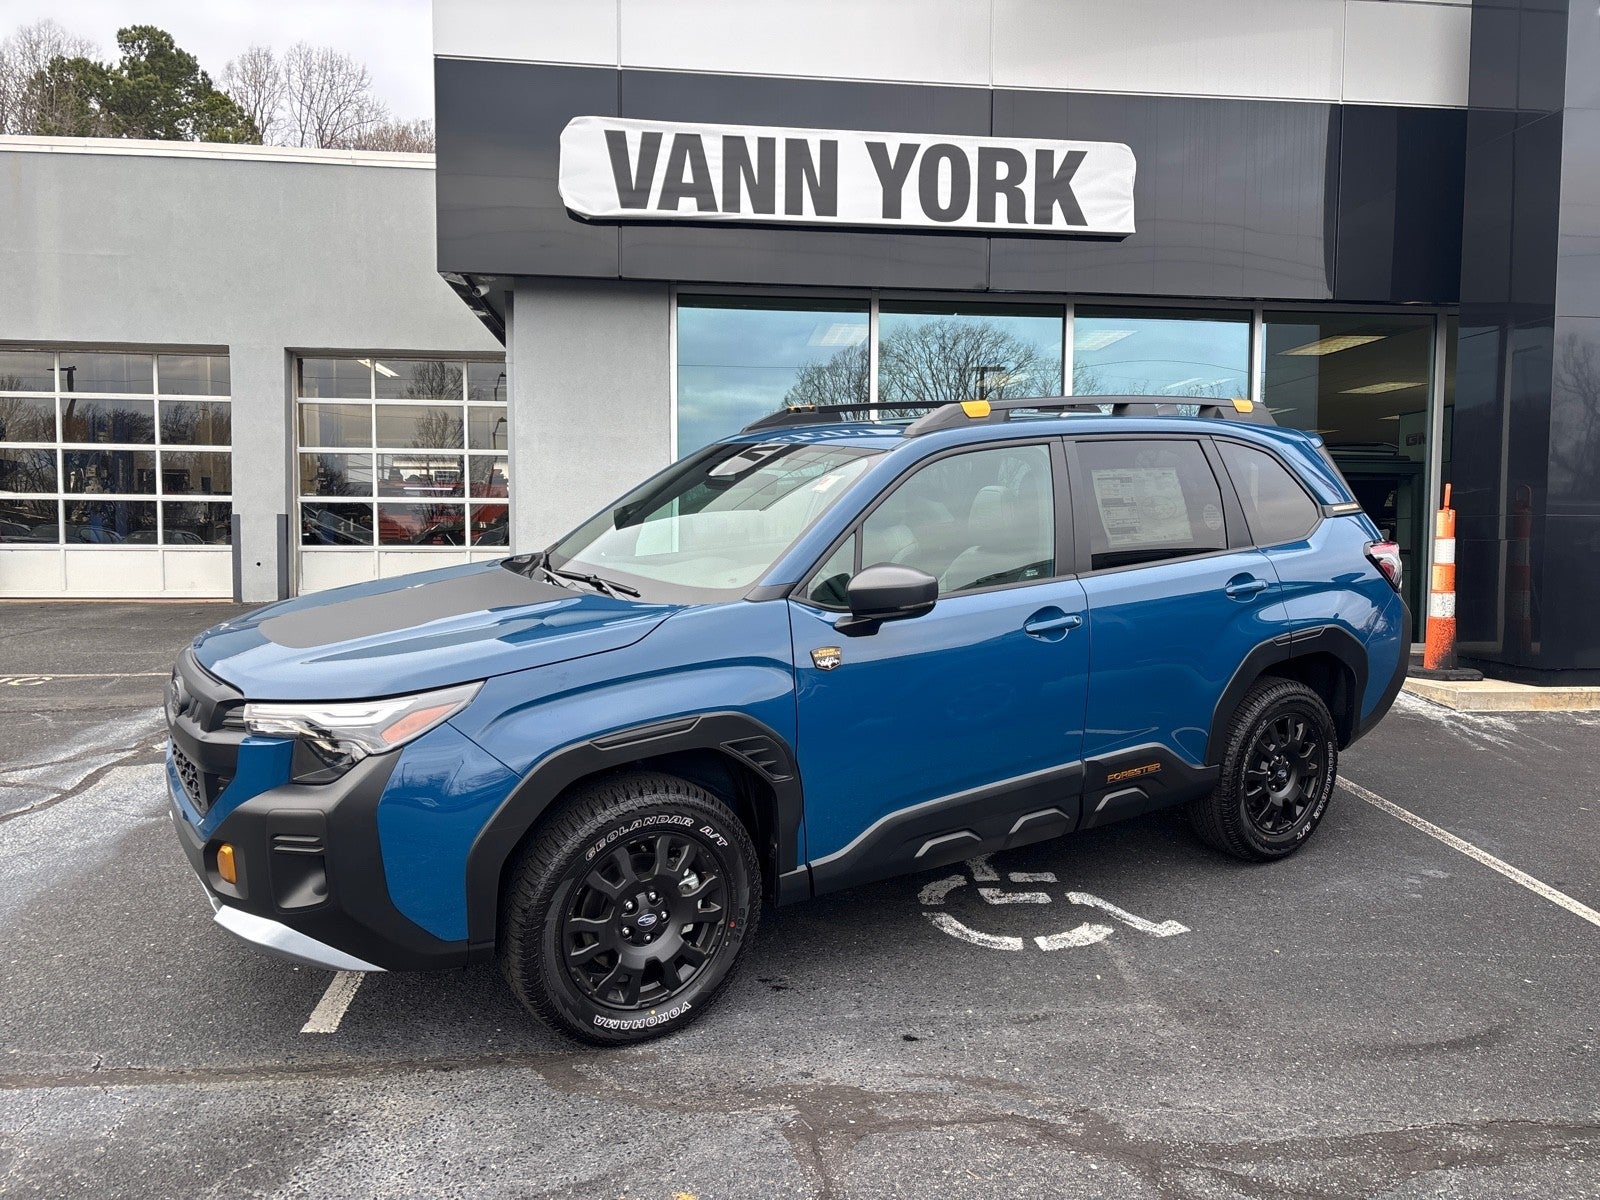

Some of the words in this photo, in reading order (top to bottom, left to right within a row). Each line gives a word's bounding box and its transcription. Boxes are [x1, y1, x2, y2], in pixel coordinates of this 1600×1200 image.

[604, 129, 838, 217] VANN
[866, 141, 1088, 226] YORK
[1107, 763, 1161, 783] FORESTER
[586, 815, 694, 860] GEOLANDAR
[699, 825, 728, 847] A/T
[594, 1002, 692, 1029] YOKOHAMA
